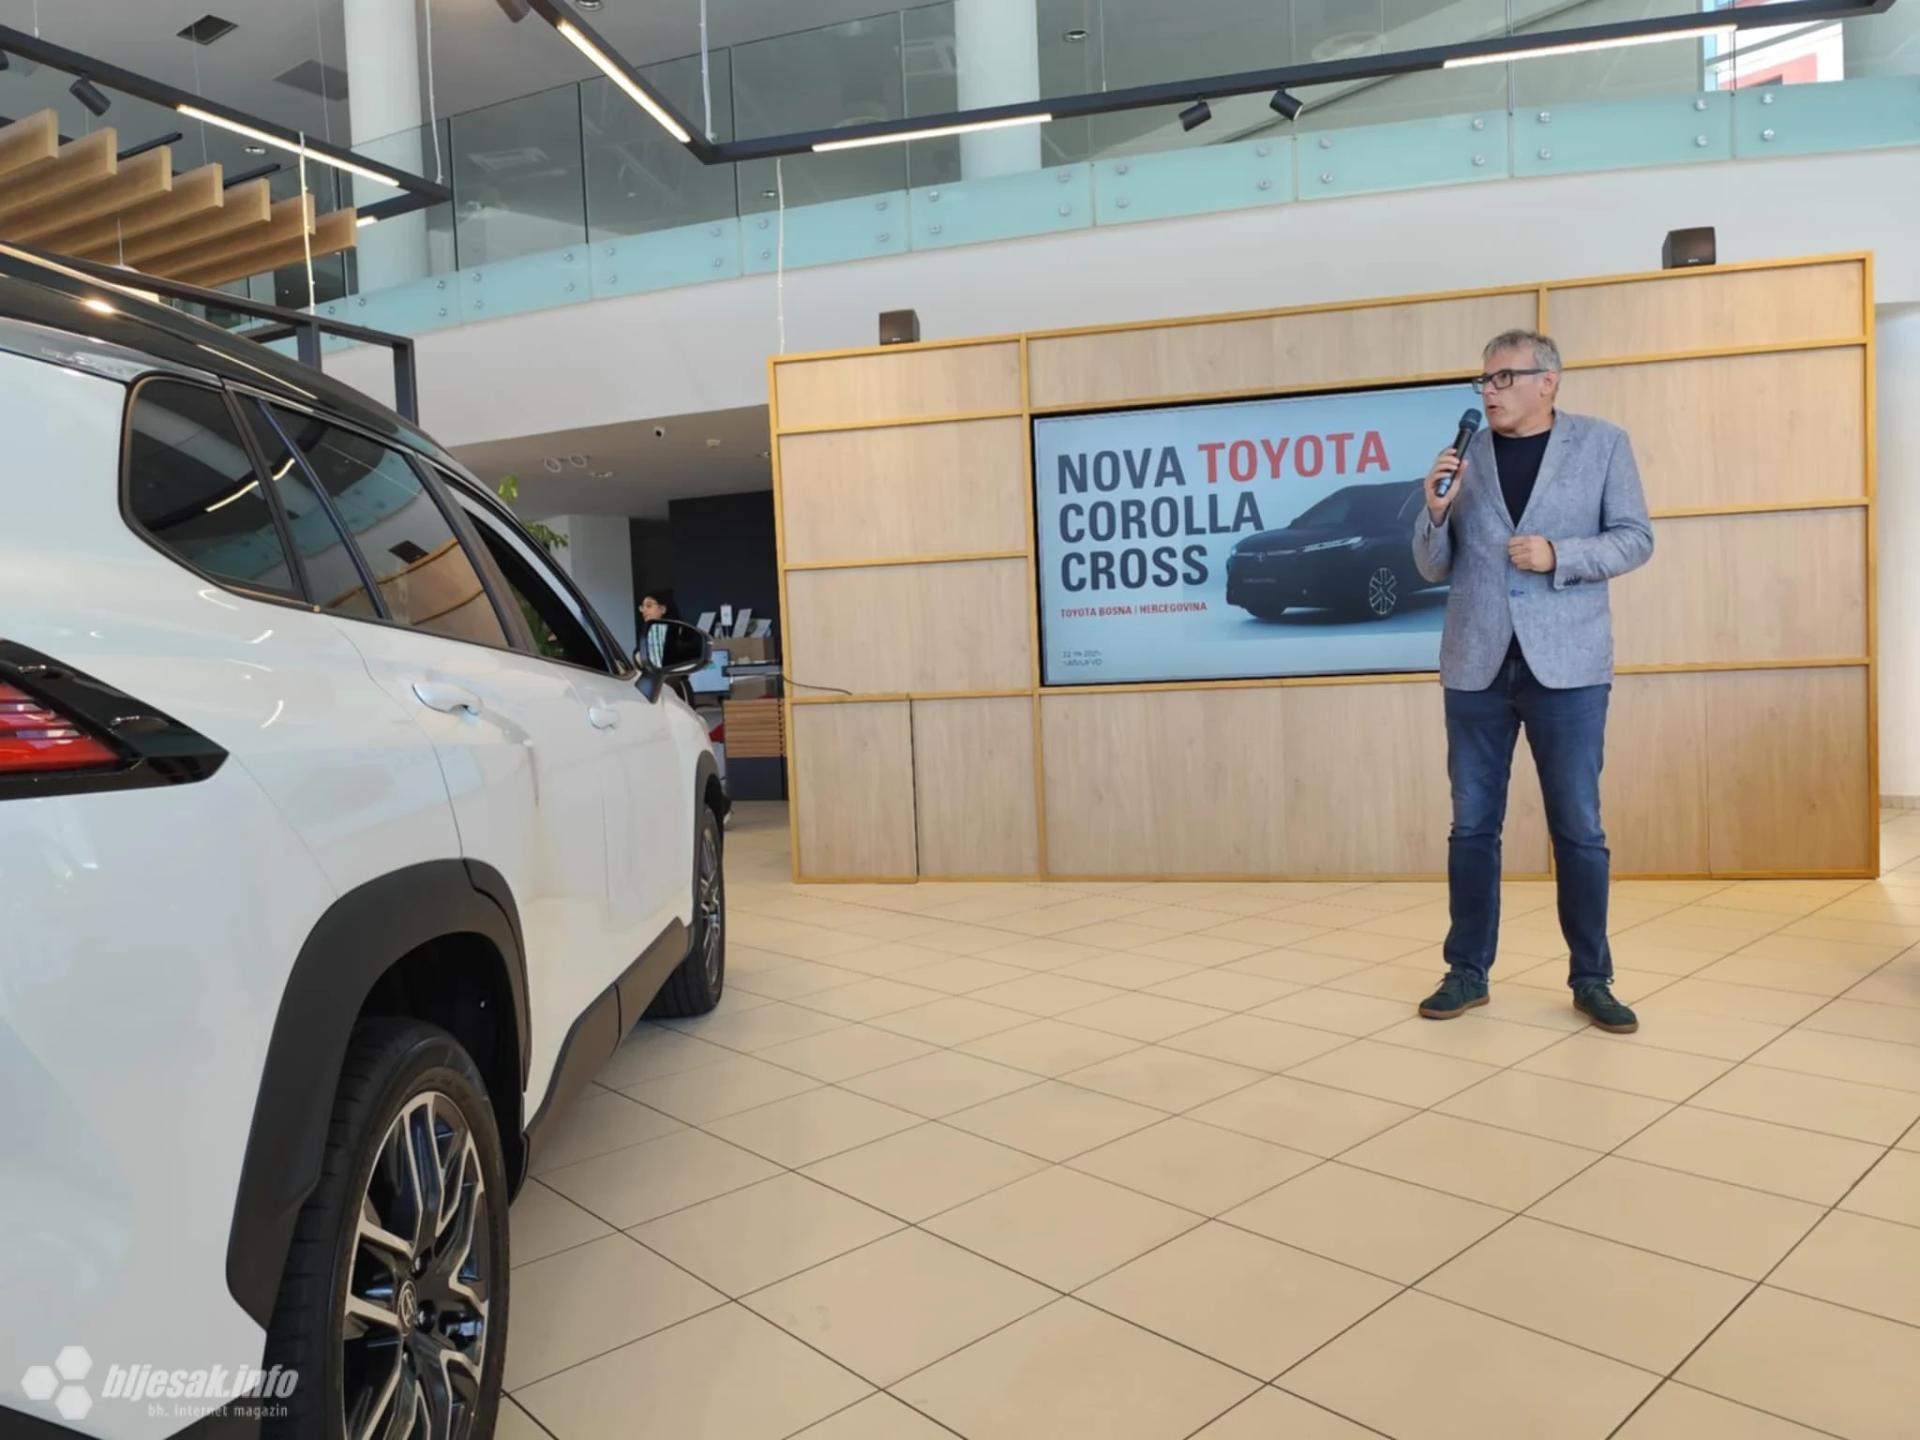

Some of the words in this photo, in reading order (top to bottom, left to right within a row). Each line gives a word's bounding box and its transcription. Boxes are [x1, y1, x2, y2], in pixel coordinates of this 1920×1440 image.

[1057, 445, 1186, 494] NOVA
[1197, 430, 1391, 484] TOYOTA
[1059, 491, 1264, 543] COROLLA
[1061, 544, 1209, 592] CROSS
[1061, 607, 1097, 619] TOYOTA
[1099, 606, 1132, 617] BOSNA
[1140, 601, 1207, 615] HERCEGOVINA
